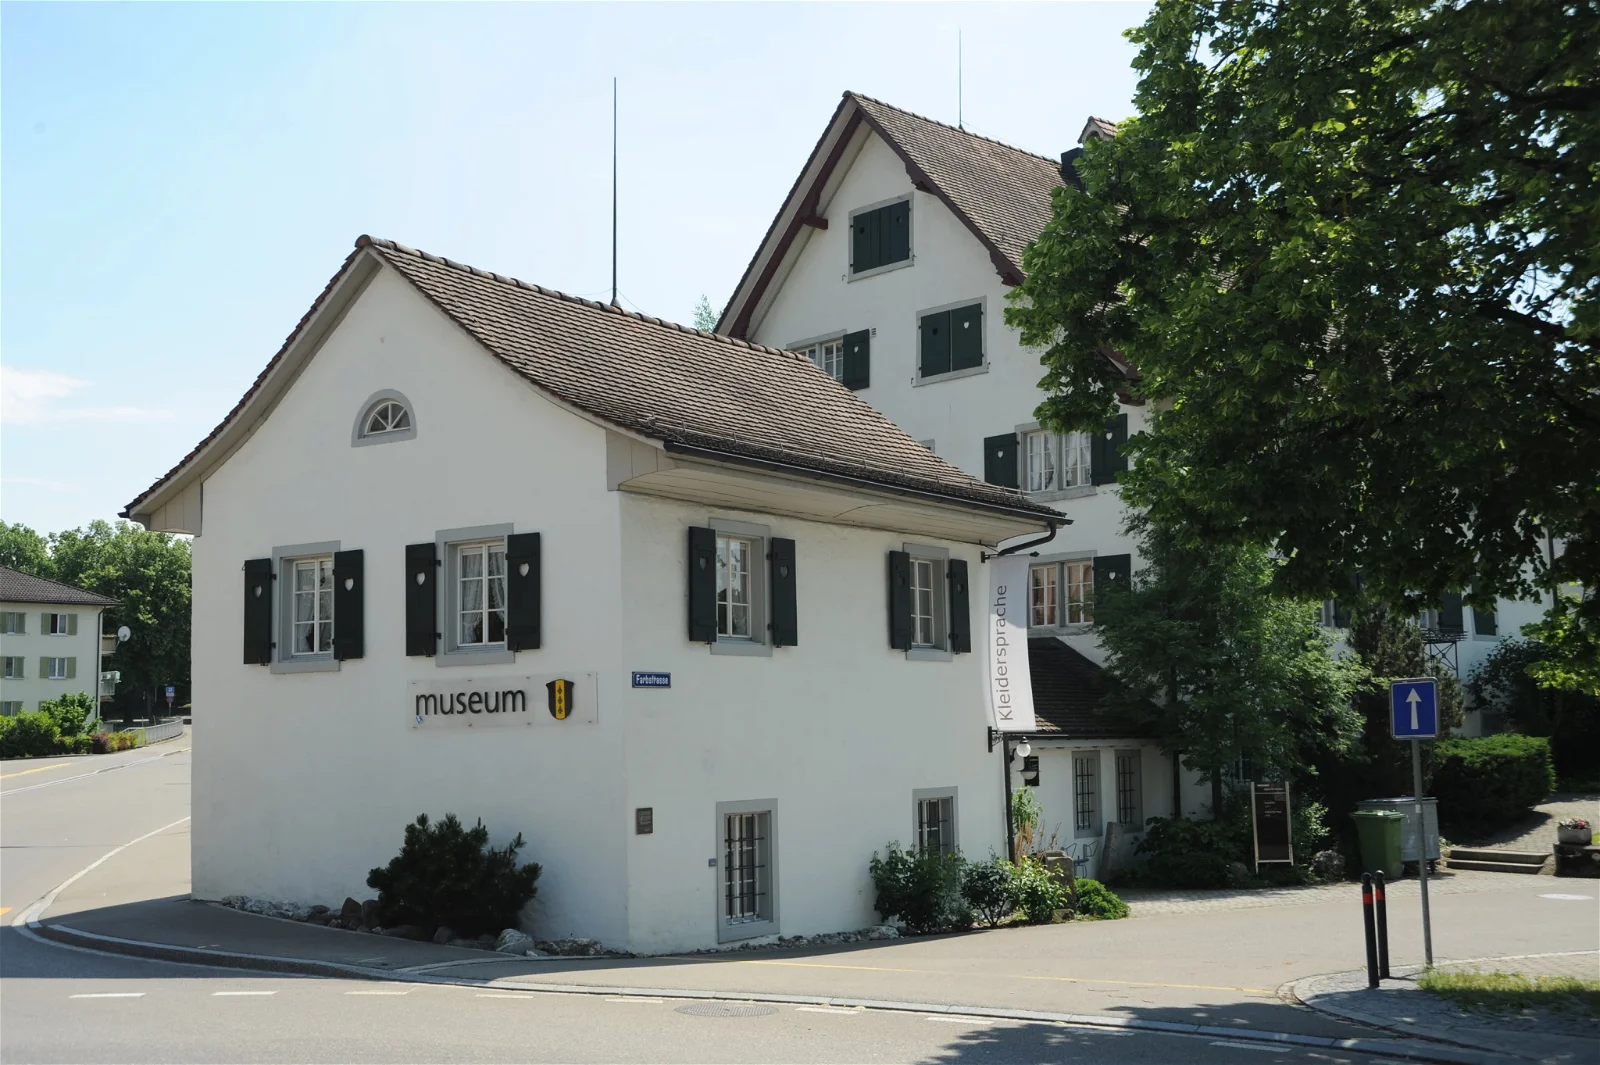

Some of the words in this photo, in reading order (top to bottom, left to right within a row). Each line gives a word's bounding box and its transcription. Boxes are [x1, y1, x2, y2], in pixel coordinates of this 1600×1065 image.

[994, 585, 1013, 721] Kleidersprache
[635, 674, 669, 685] Farbstrasse
[415, 688, 527, 716] museum
